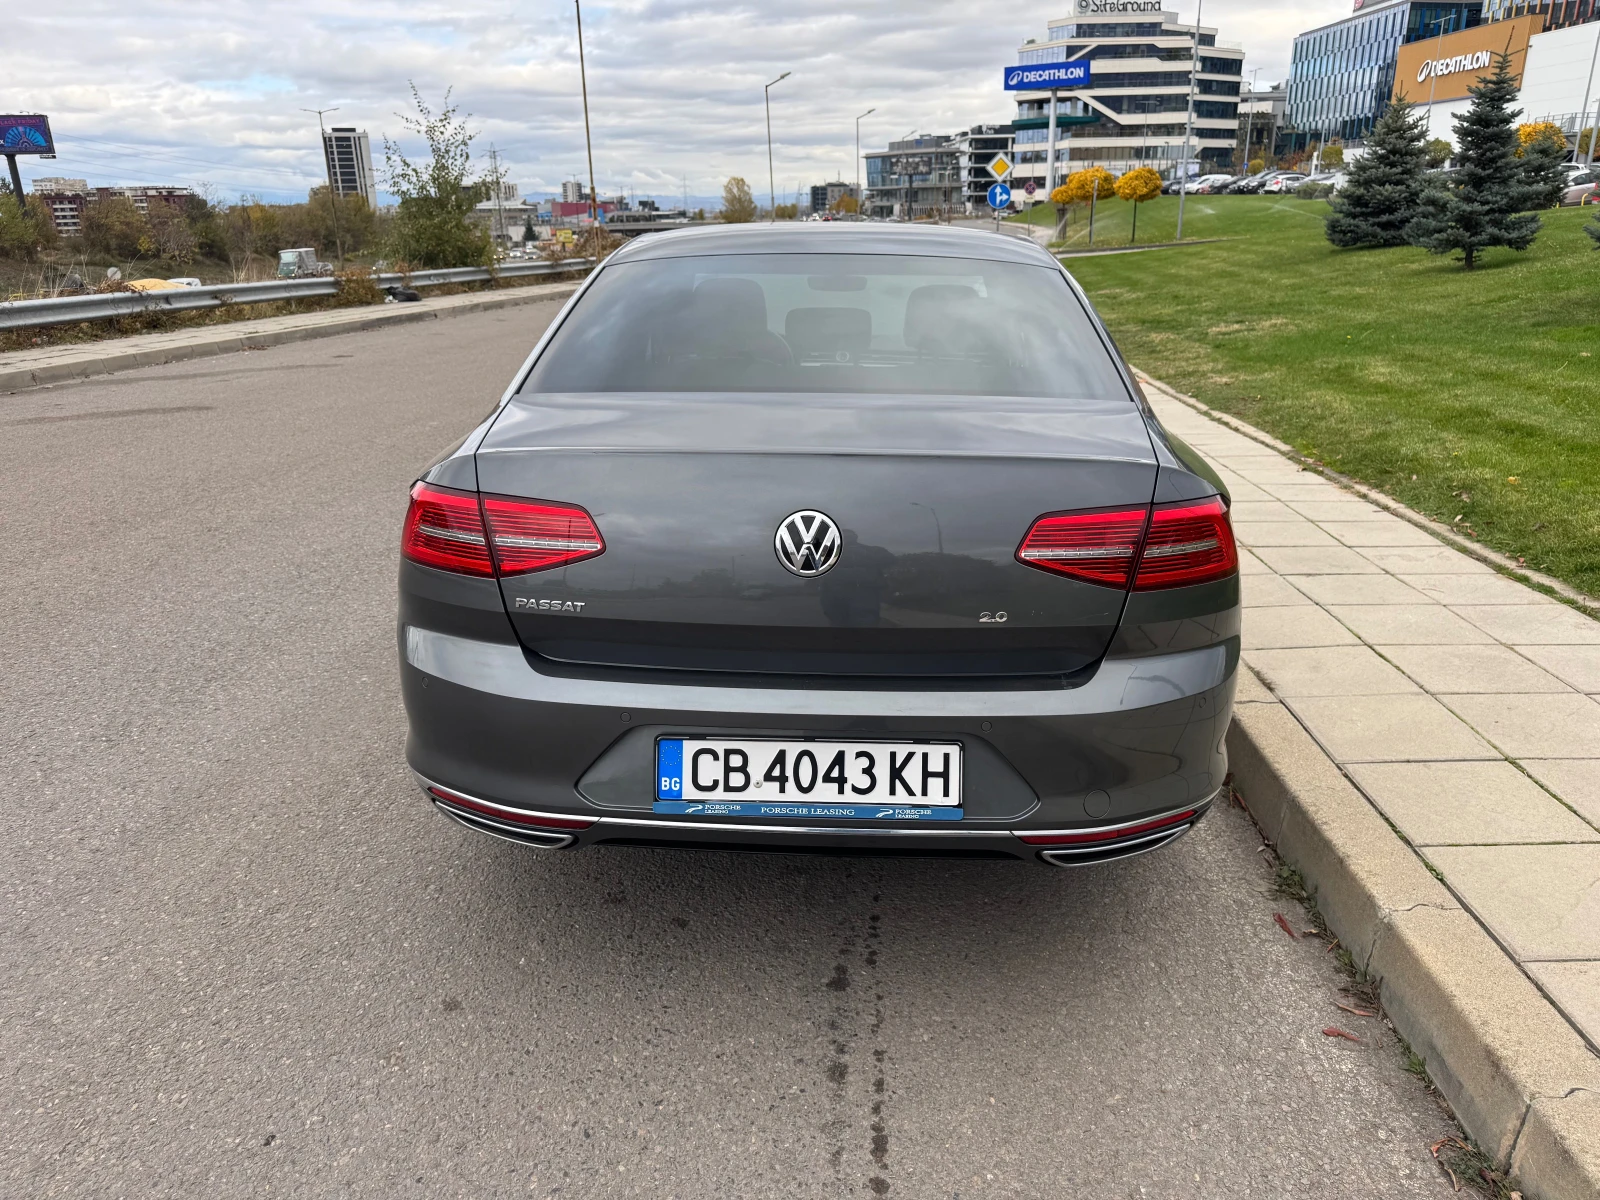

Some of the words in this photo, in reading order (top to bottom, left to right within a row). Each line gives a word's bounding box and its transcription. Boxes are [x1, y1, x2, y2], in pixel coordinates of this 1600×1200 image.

[1090, 0, 1162, 13] SiteGround
[1431, 50, 1491, 77] DECATHLON
[1023, 67, 1084, 83] DECATHLON
[515, 597, 586, 613] PASSAT
[979, 611, 1008, 623] 2.0
[691, 747, 751, 793] CB
[763, 749, 877, 796] 4043
[889, 750, 951, 798] KH
[661, 776, 681, 791] BG
[760, 806, 809, 815] PORSCHE
[811, 808, 856, 816] LEASING
